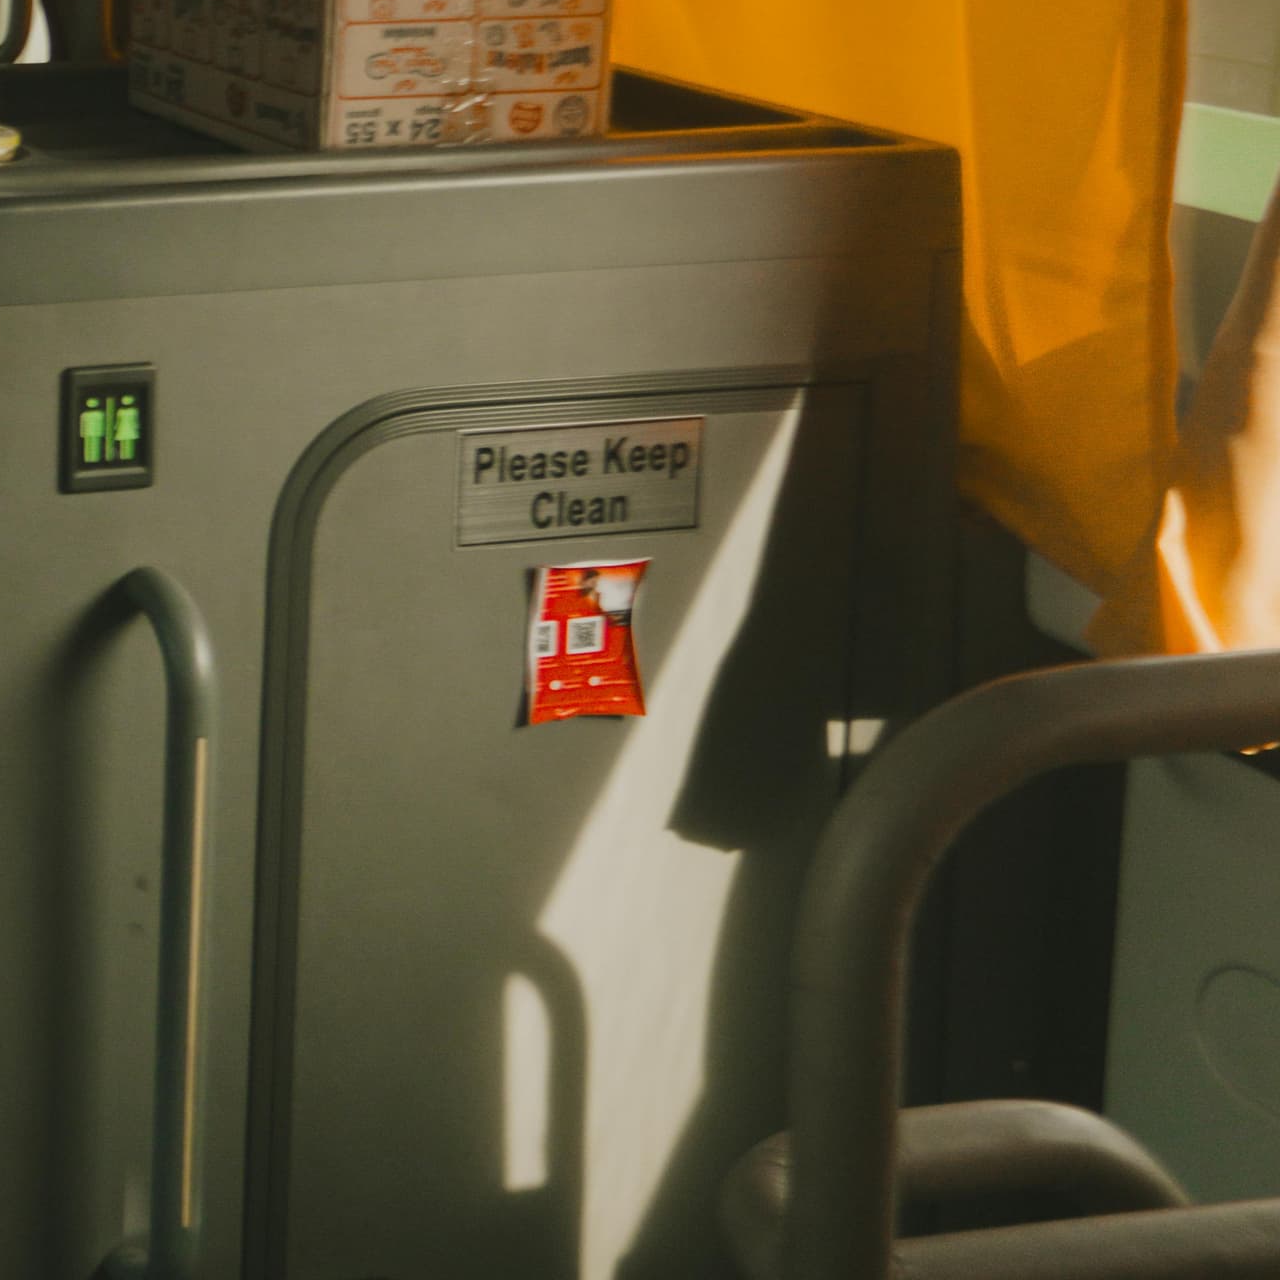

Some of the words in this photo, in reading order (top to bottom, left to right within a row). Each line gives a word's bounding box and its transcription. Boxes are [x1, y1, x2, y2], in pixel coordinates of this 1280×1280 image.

[346, 122, 376, 144] 55
[410, 119, 441, 141] 24
[474, 447, 589, 484] Please
[603, 437, 688, 479] Keep
[531, 491, 628, 529] Clean
